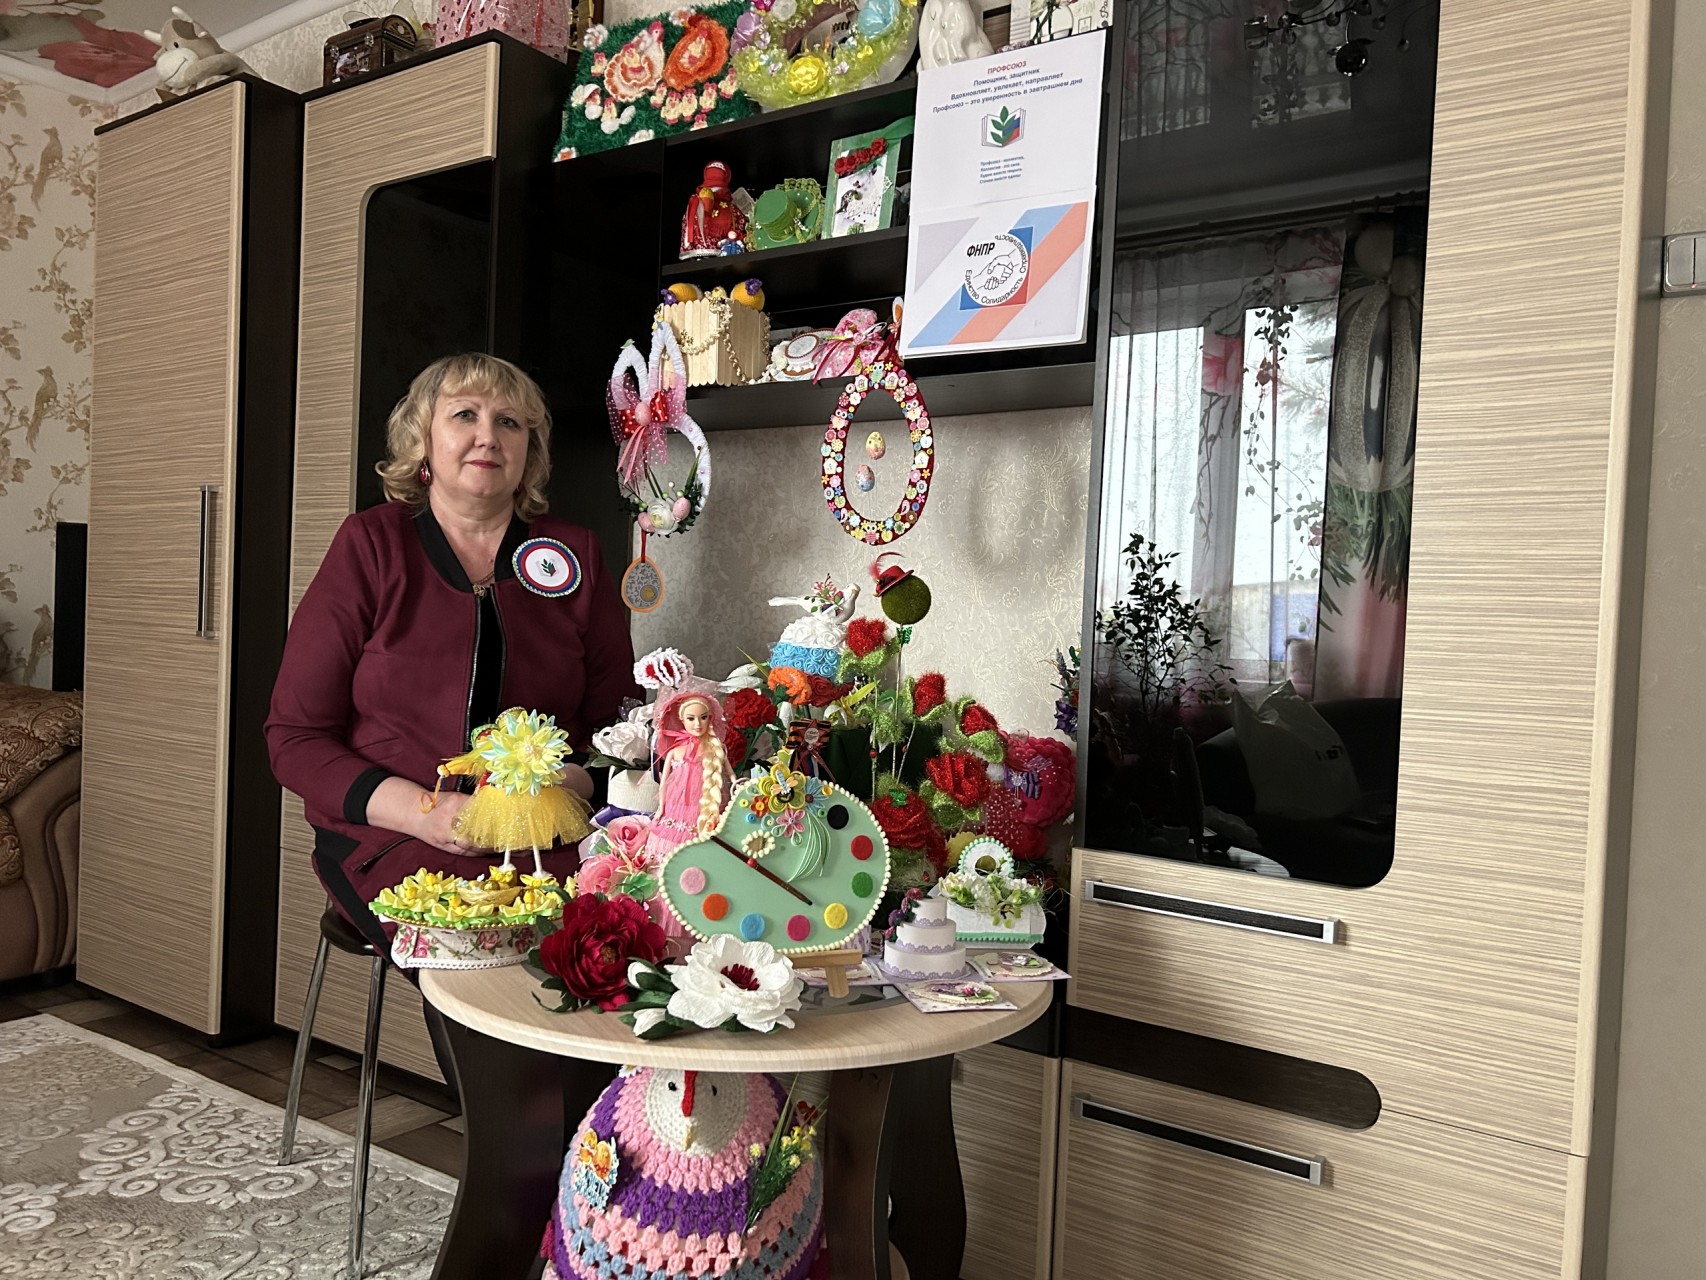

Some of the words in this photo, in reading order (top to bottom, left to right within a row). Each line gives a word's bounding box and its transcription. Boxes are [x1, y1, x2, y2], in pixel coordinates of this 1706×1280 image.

[974, 75, 1008, 86] Помощник,
[1009, 68, 1040, 79] защитник
[988, 60, 1026, 74] ПРОФСОЮЗ
[933, 102, 964, 113] Профсоюз
[982, 91, 1022, 104] уверенность
[1029, 81, 1068, 94] завтрашнем
[1070, 78, 1083, 86] дне
[950, 88, 992, 100] Вдохновляет,
[994, 80, 1024, 93] увлекает,
[1026, 72, 1063, 85] направляет
[966, 242, 995, 257] ФНПР
[995, 235, 1028, 273] Справедливость
[965, 270, 980, 299] Единство
[981, 277, 1023, 304] Солидарность
